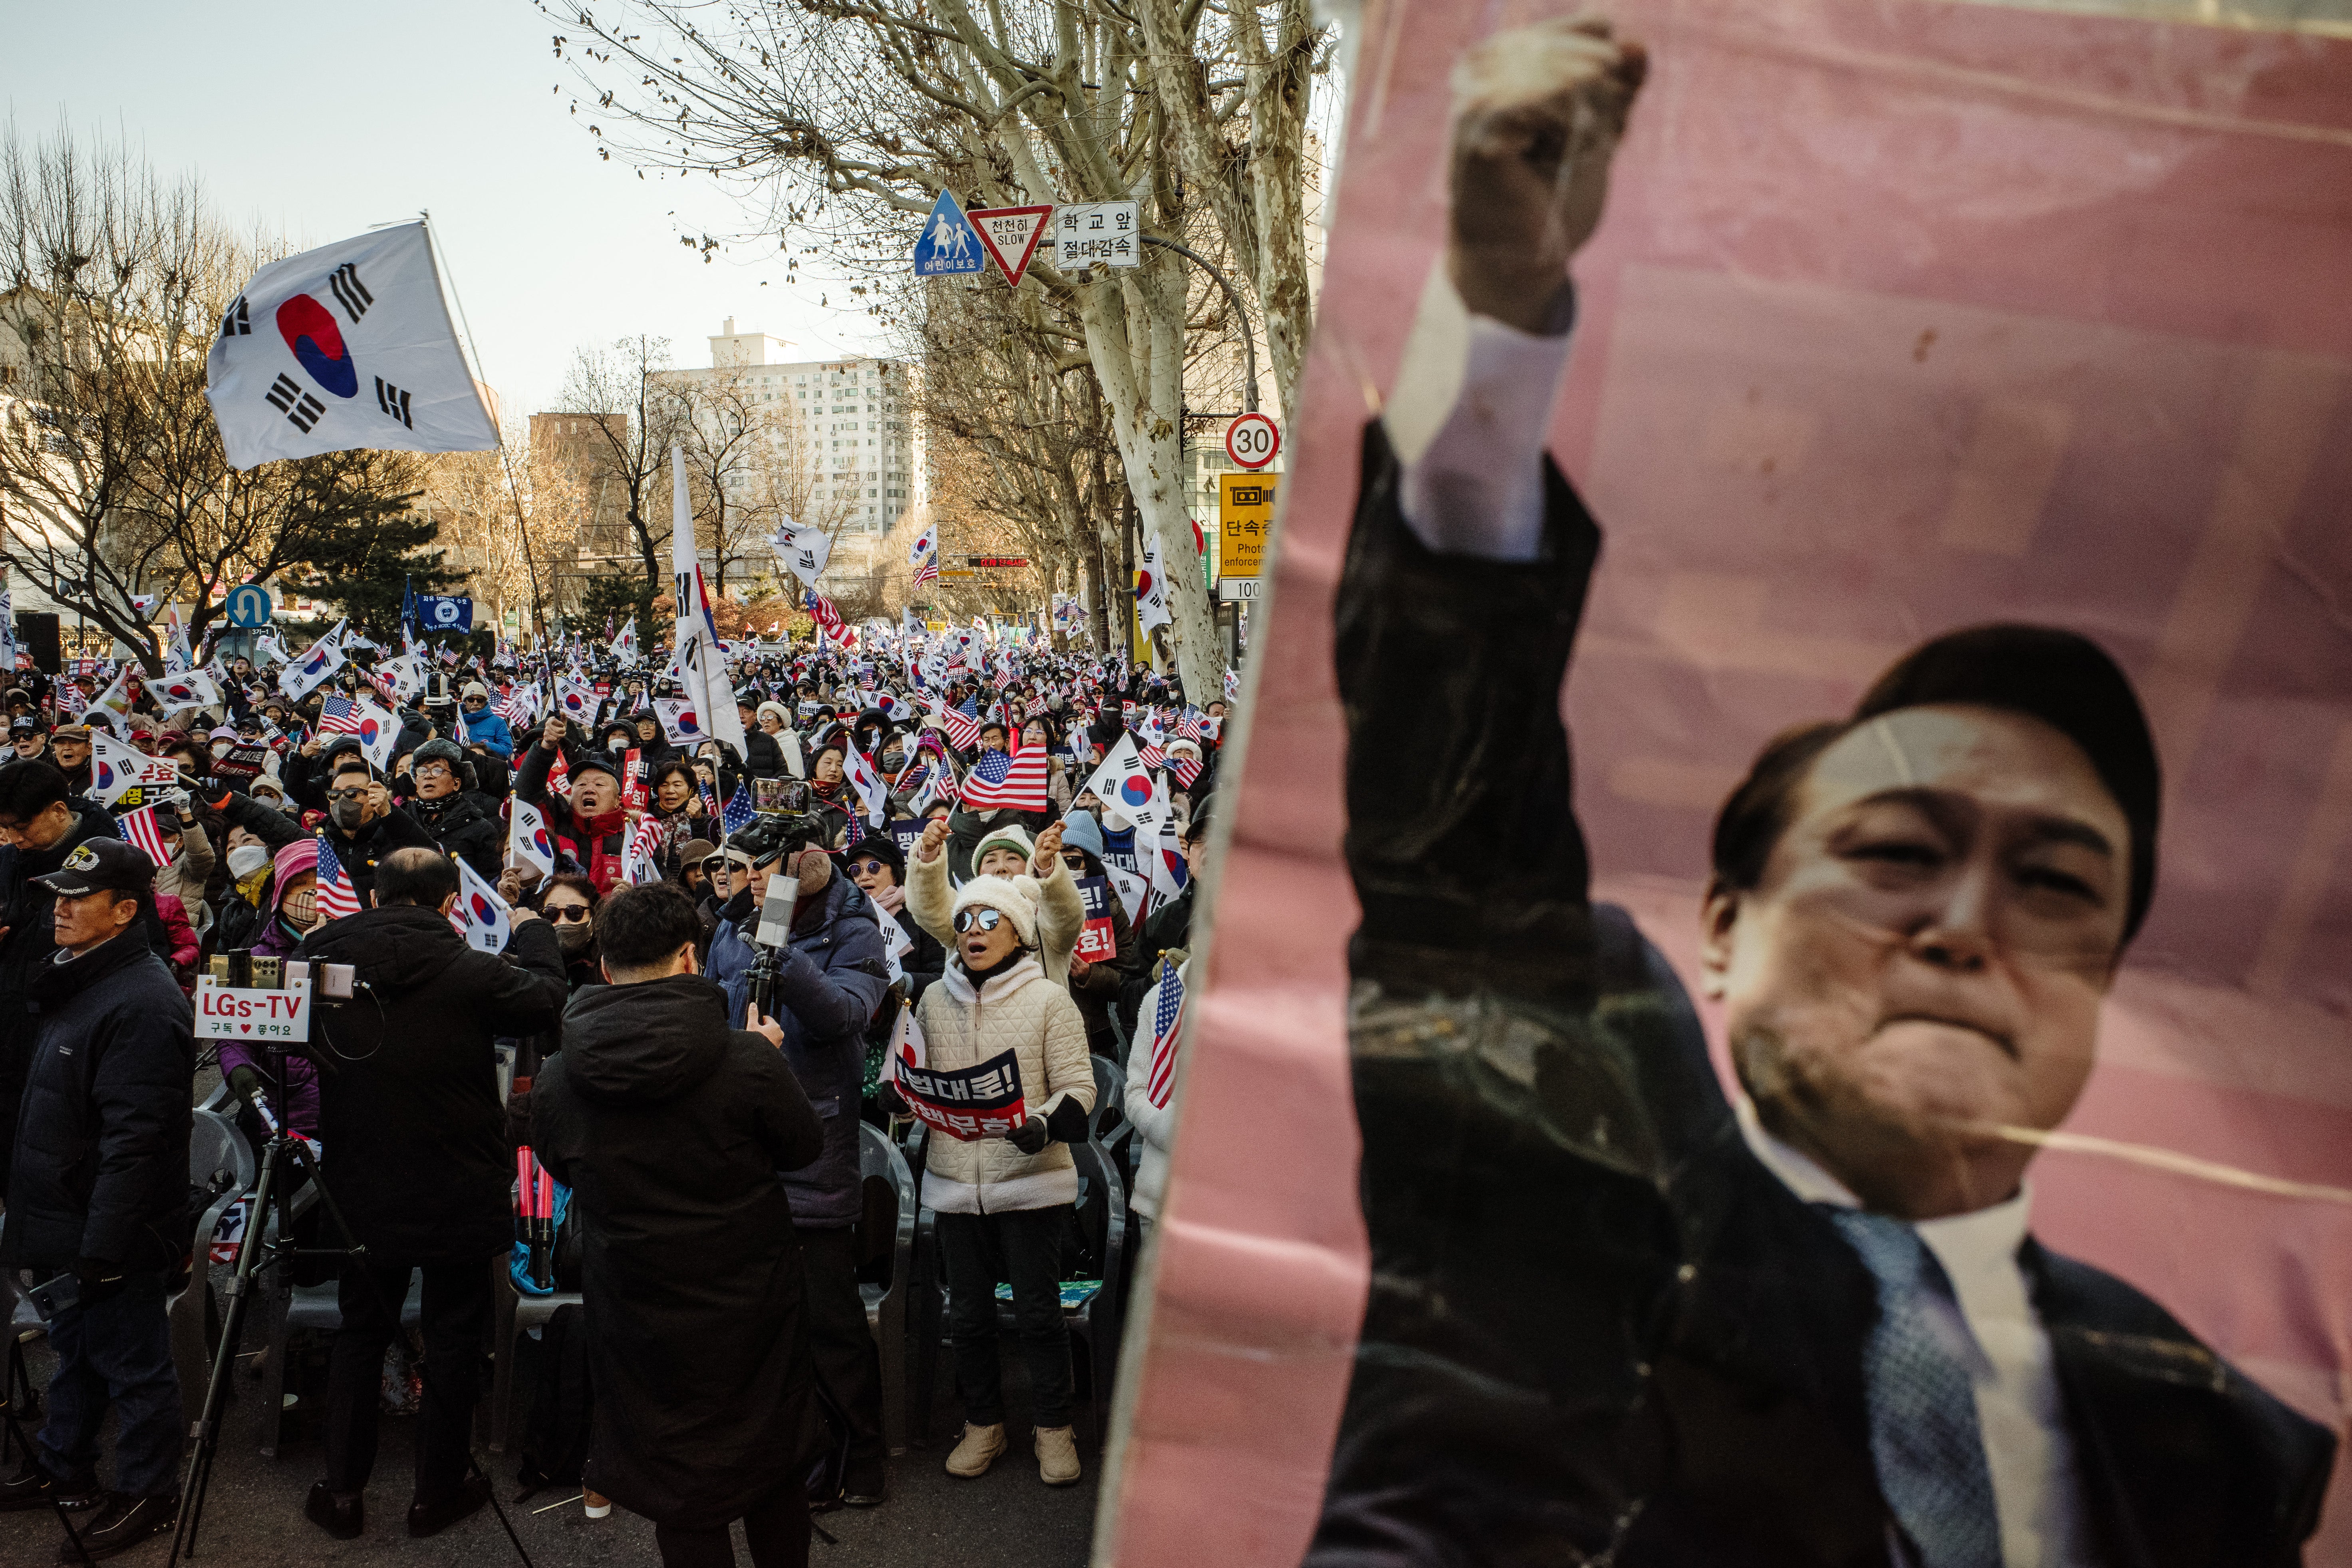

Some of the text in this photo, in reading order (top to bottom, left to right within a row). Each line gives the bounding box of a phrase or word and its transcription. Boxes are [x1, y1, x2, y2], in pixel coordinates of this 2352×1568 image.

[992, 219, 1028, 233] 천천히
[998, 234, 1025, 245] SLOW
[1063, 238, 1131, 259] 절대감속
[924, 258, 976, 271] 어린이보호
[1237, 428, 1269, 453] 30
[58, 886, 90, 894] AIRBORNE
[203, 993, 302, 1019] LGs-TV
[211, 1022, 291, 1035] 구독 좋아요
